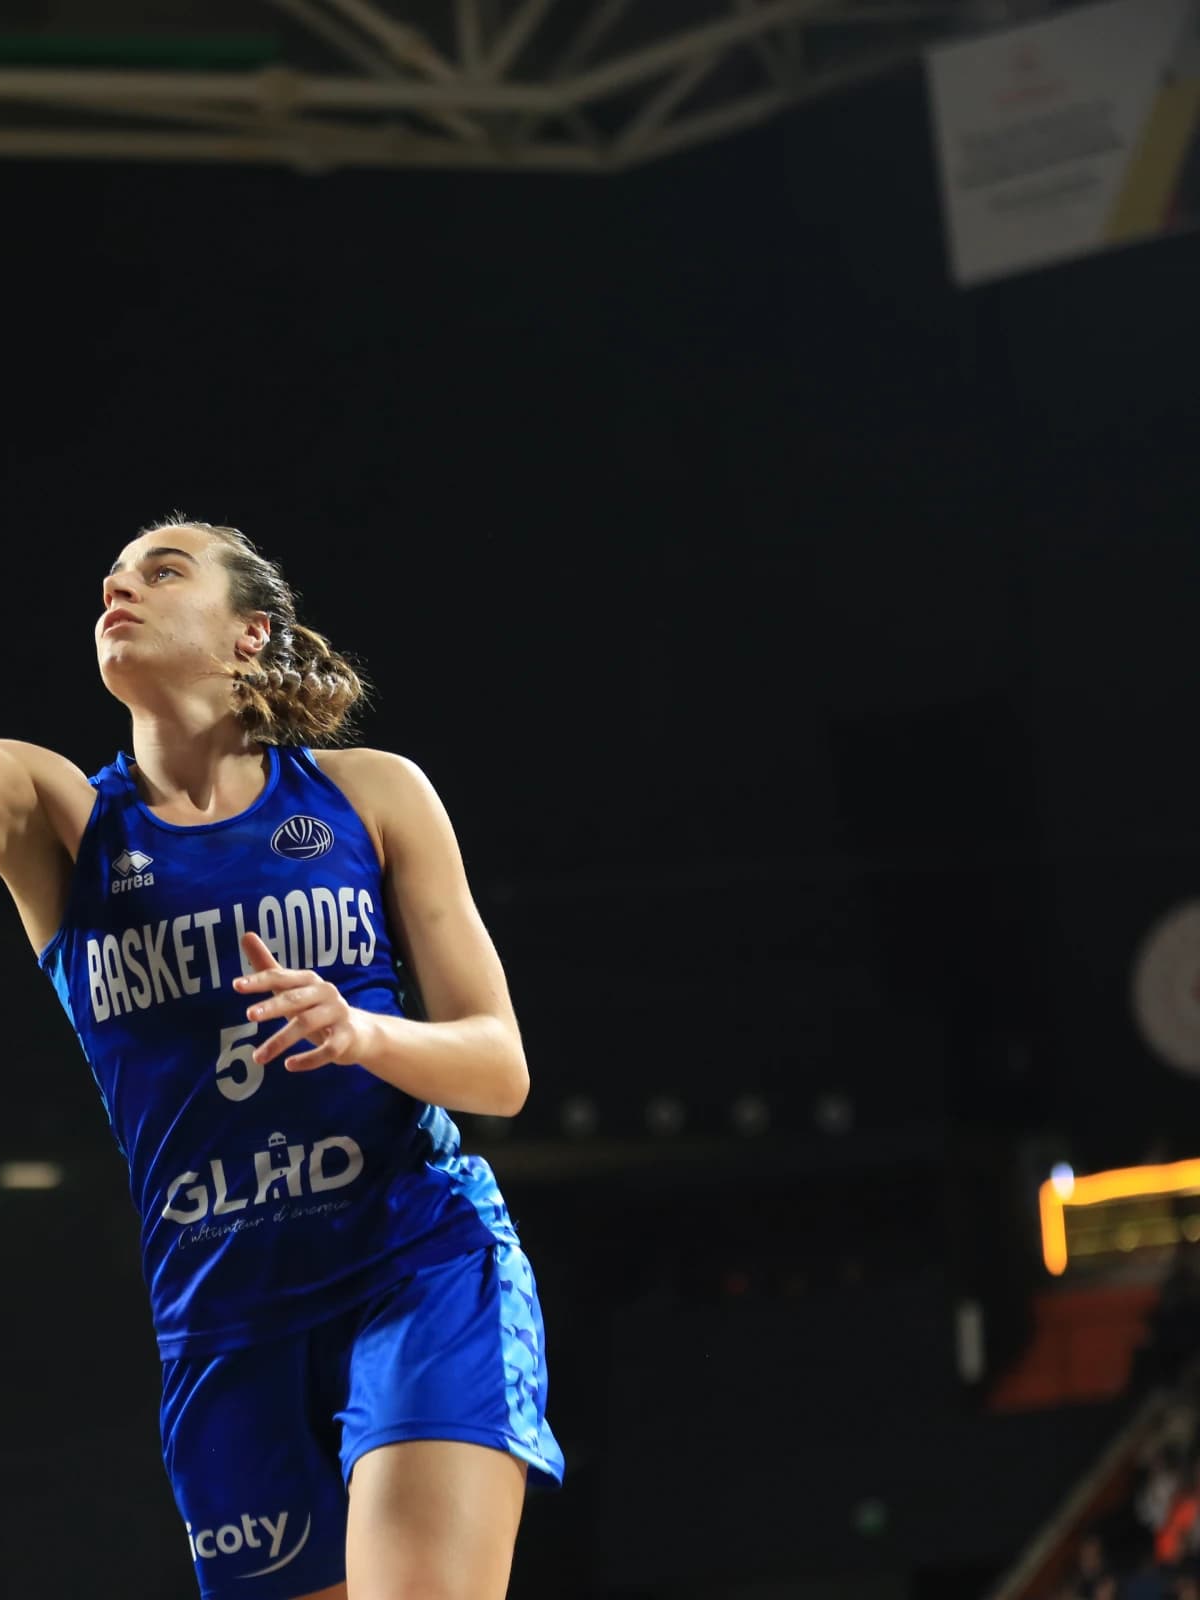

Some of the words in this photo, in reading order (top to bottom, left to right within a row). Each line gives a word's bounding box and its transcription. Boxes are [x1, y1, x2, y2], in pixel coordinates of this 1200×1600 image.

[87, 907, 222, 1024] BASKET
[233, 887, 377, 977] LANDES
[215, 1023, 265, 1102] 5
[161, 1131, 365, 1225] GLHD
